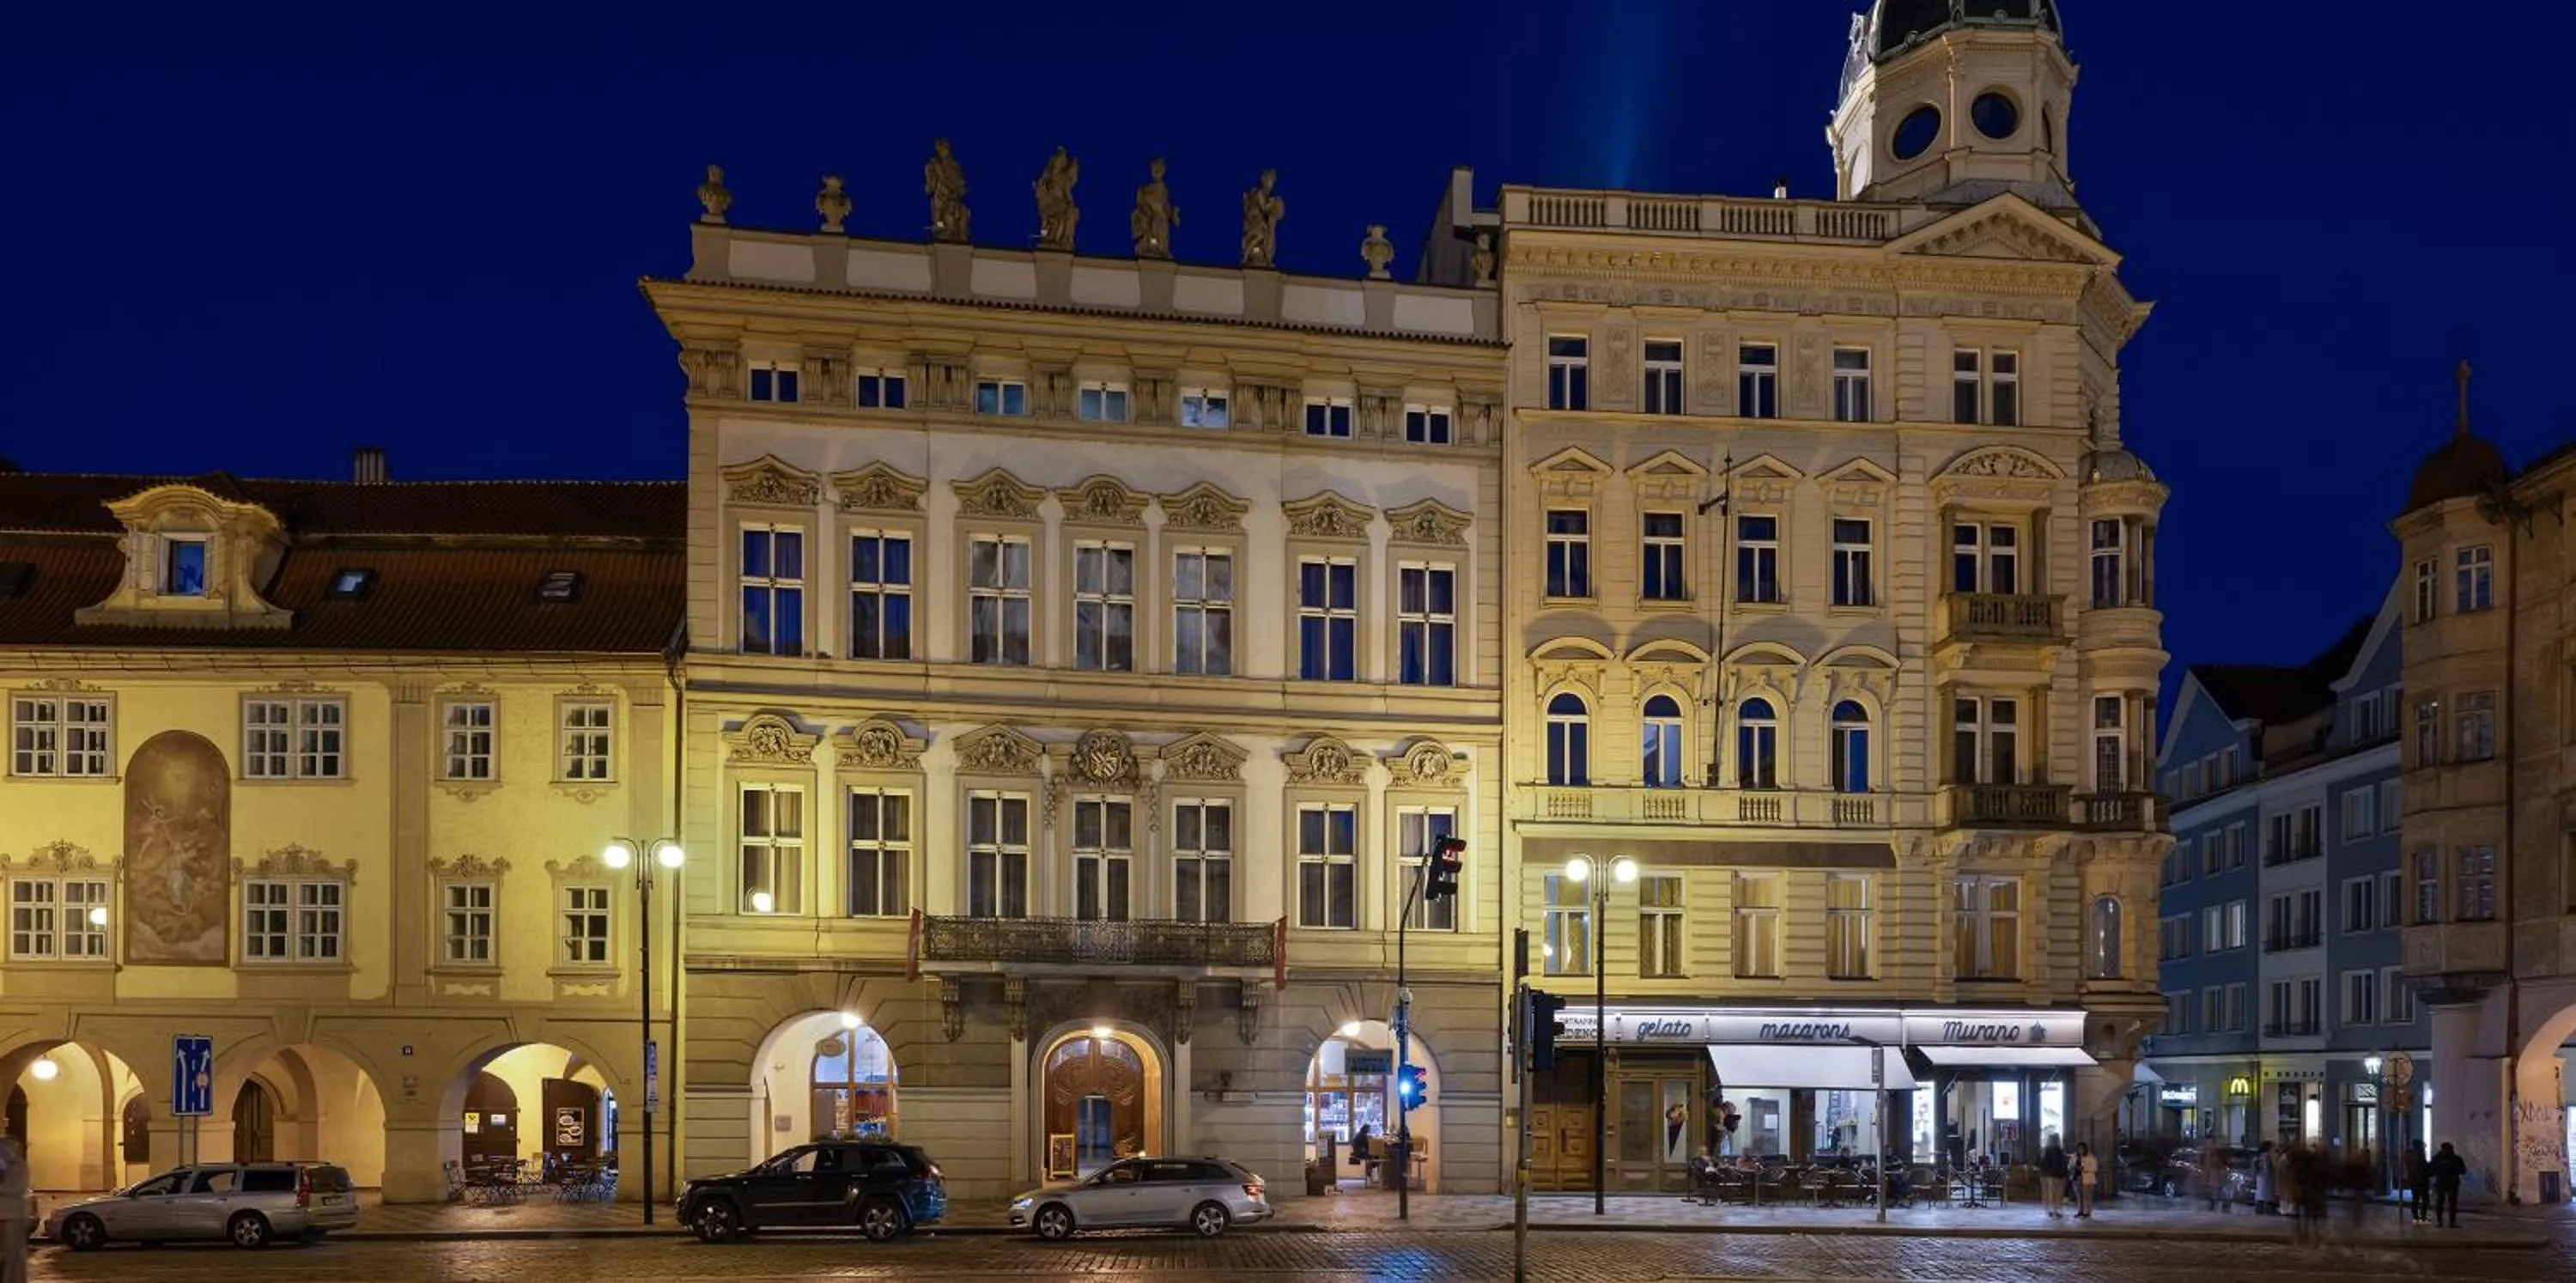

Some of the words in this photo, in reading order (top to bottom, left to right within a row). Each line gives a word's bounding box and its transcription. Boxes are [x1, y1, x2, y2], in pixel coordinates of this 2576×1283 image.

[1637, 1018, 1692, 1042] gelato
[1759, 1022, 1850, 1039] macarons
[1943, 1020, 2020, 1041] Murano
